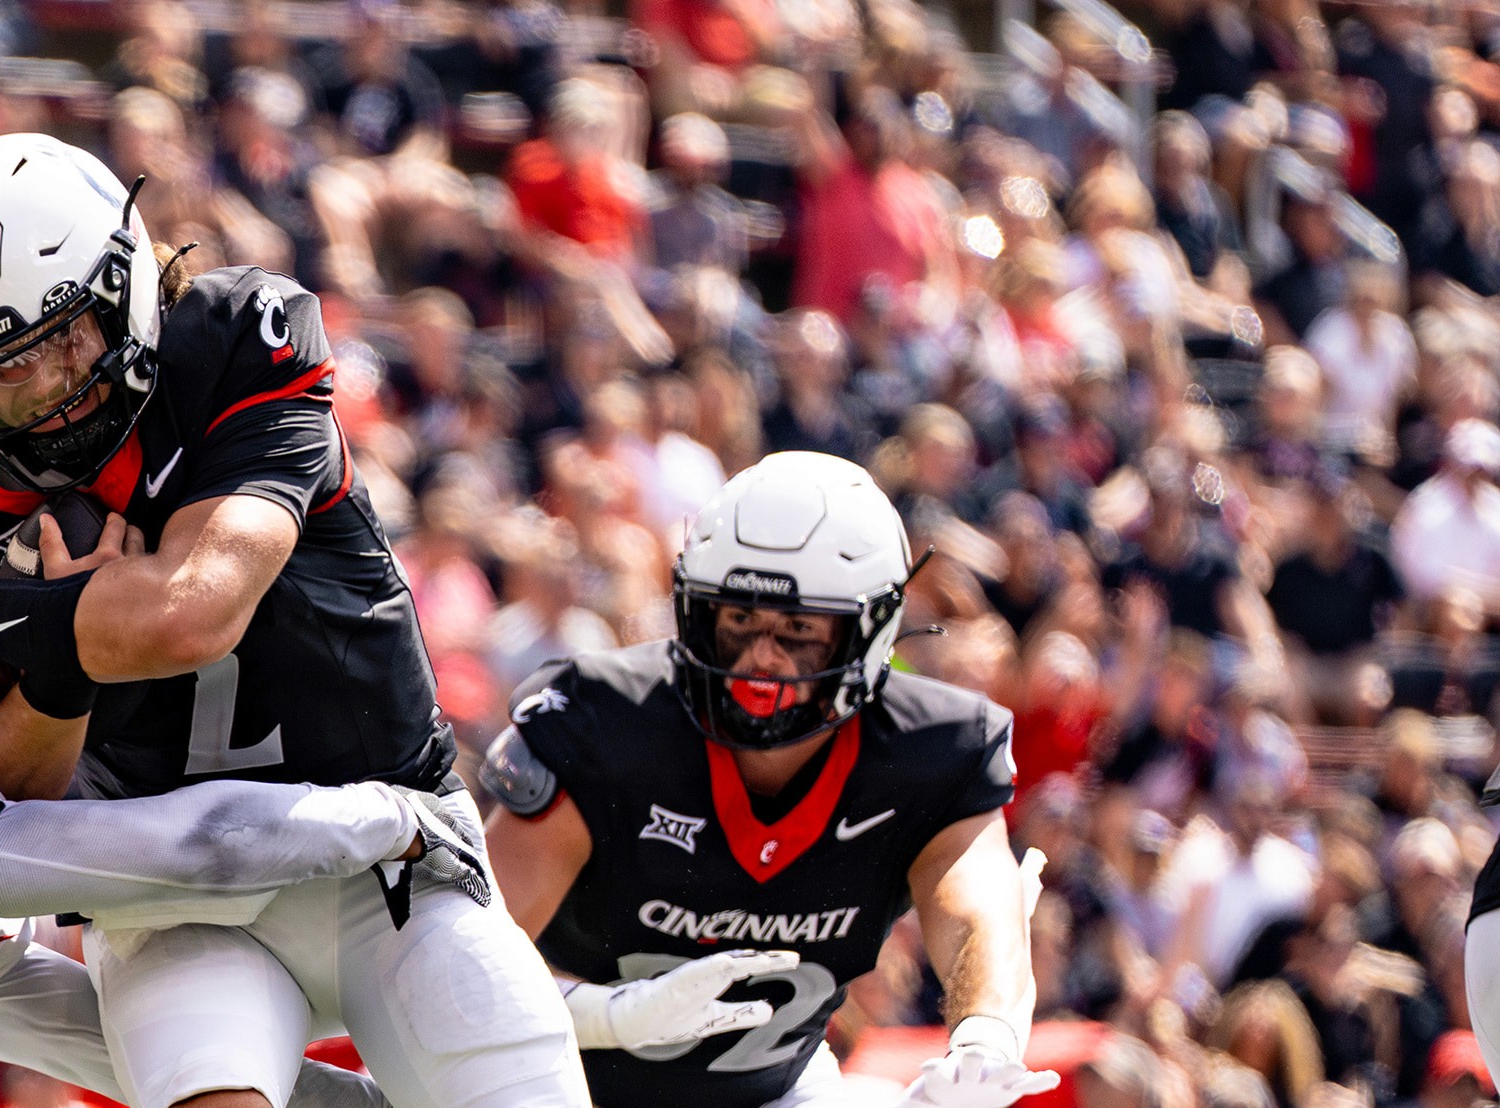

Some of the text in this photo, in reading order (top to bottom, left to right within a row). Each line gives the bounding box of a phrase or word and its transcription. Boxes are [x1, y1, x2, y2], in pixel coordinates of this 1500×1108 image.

[43, 286, 78, 313] OAKLEY
[638, 803, 708, 855] XII
[637, 899, 861, 944] CINCINNATI
